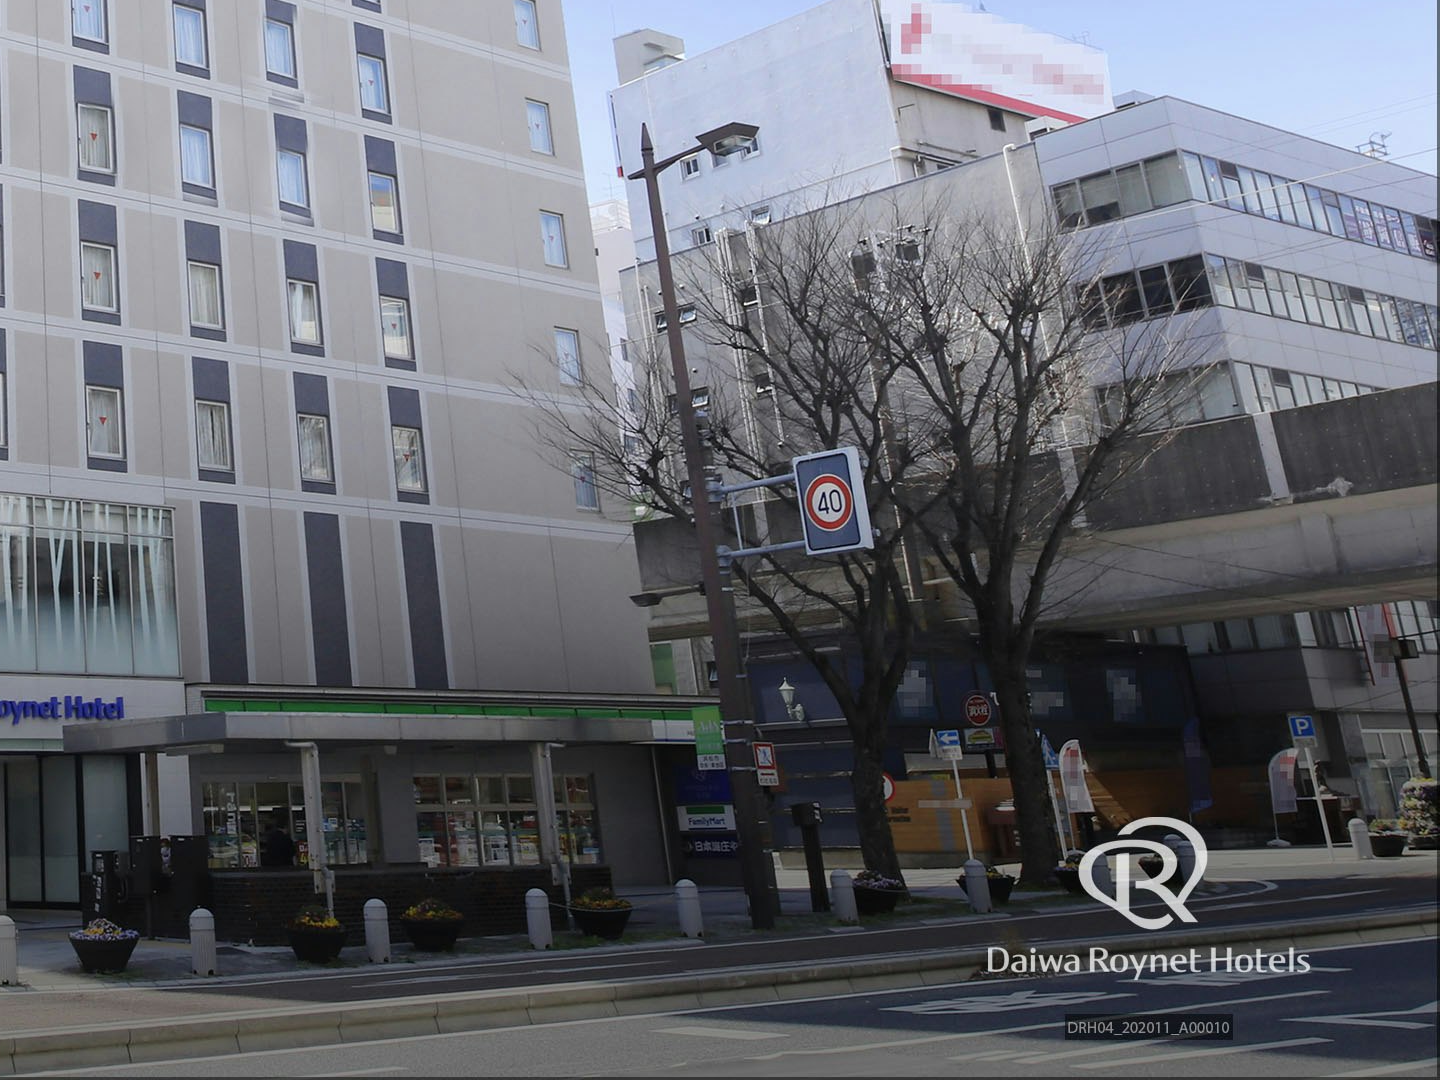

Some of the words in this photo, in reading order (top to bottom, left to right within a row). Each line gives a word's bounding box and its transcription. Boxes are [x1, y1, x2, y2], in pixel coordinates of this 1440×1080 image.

[818, 489, 843, 514] 40
[64, 696, 125, 720] Hotel
[1295, 718, 1310, 735] P
[688, 817, 726, 829] FamilyMart
